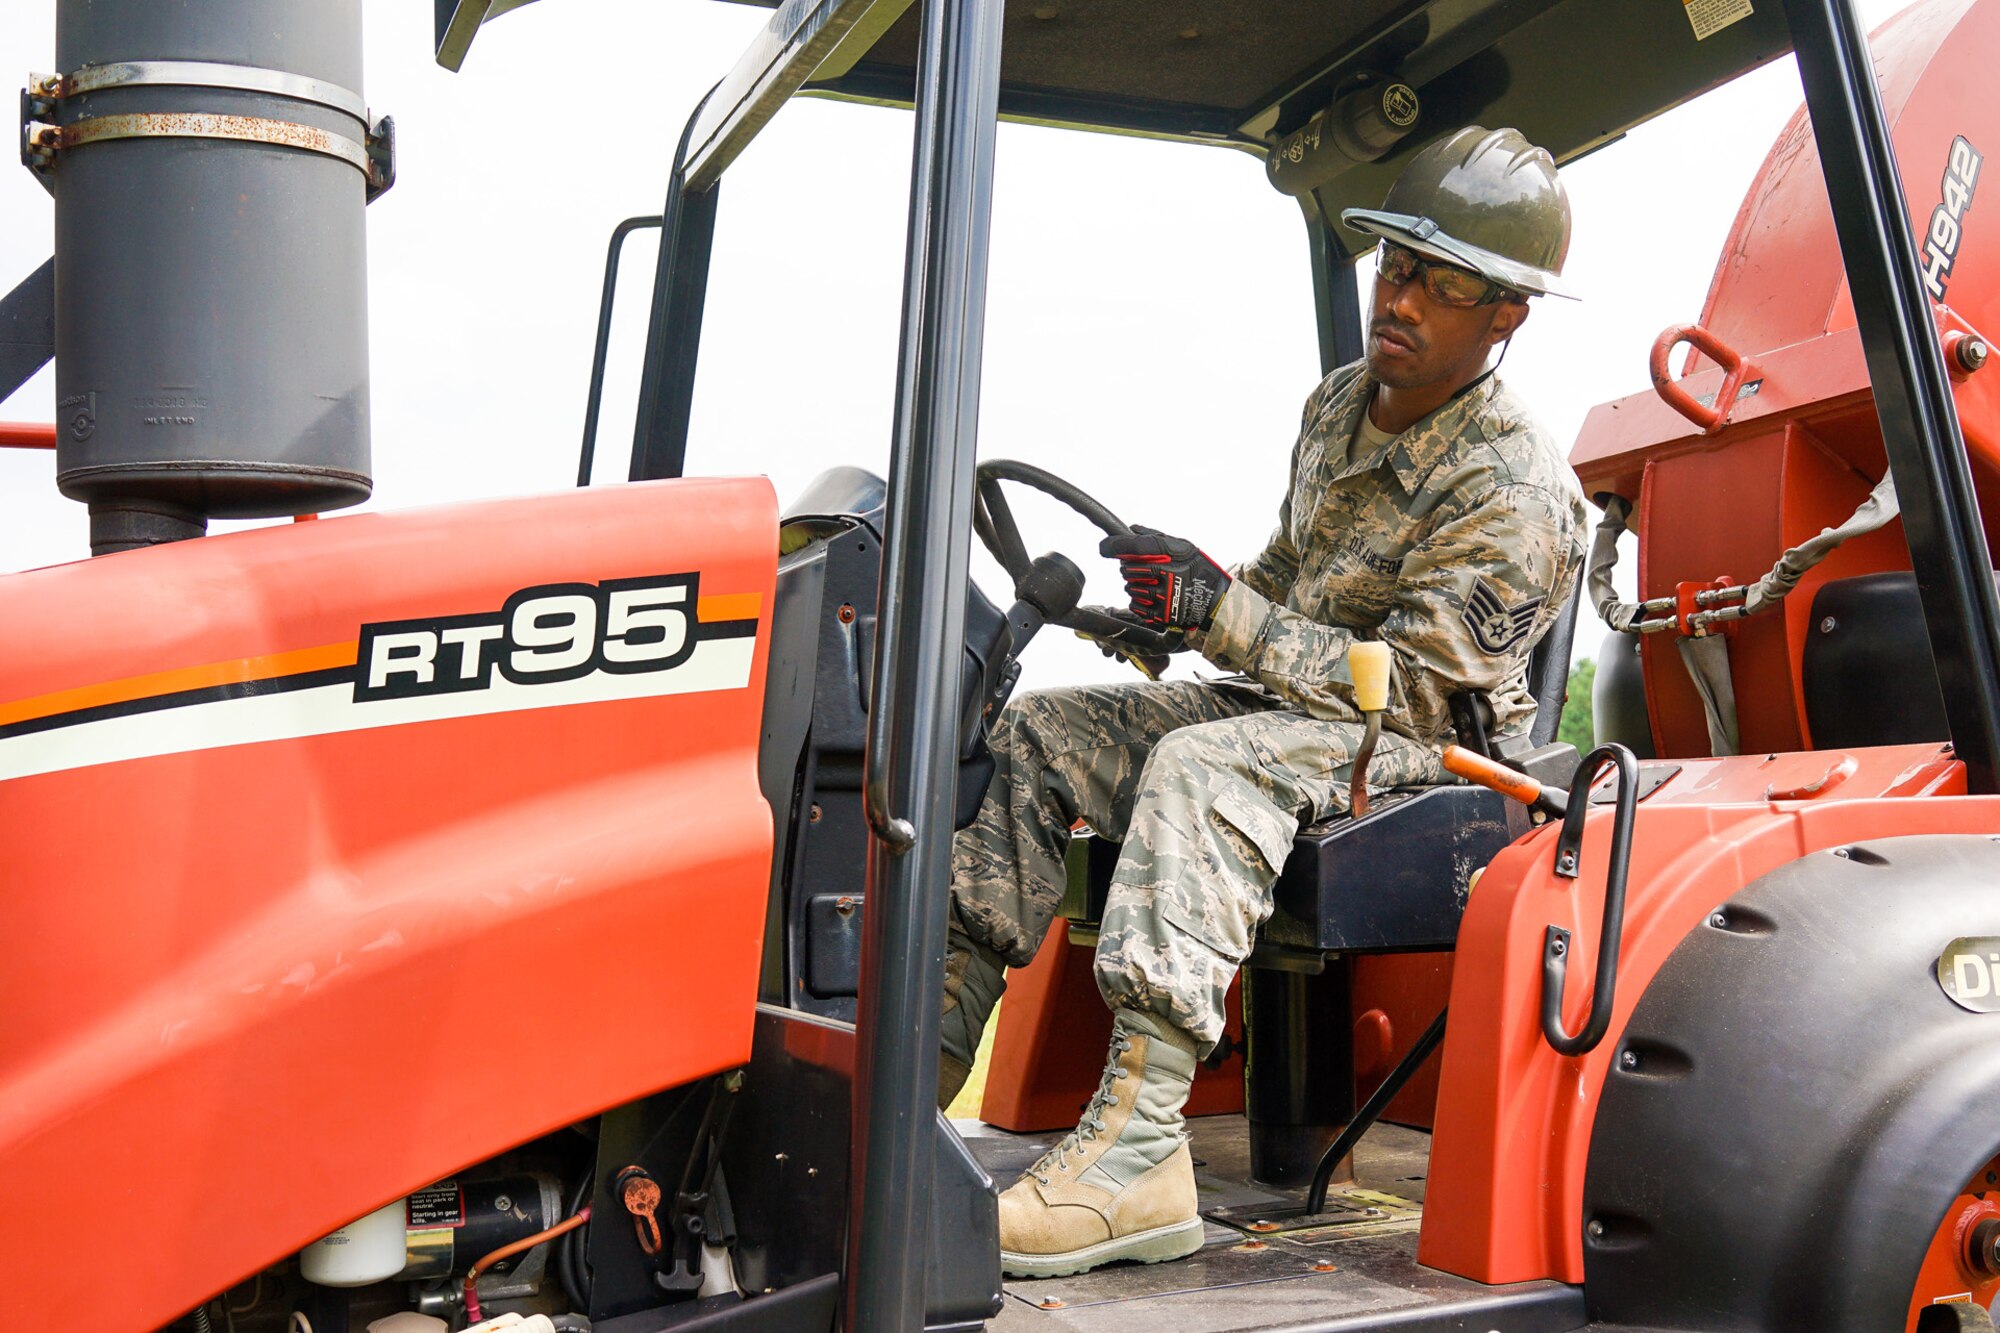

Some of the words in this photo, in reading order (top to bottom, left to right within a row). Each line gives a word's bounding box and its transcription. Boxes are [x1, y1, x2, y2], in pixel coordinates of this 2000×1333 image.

[1924, 140, 1979, 297] H942
[1359, 547, 1377, 570] AIR
[368, 585, 689, 689] RT95
[1953, 953, 2000, 999] Di
